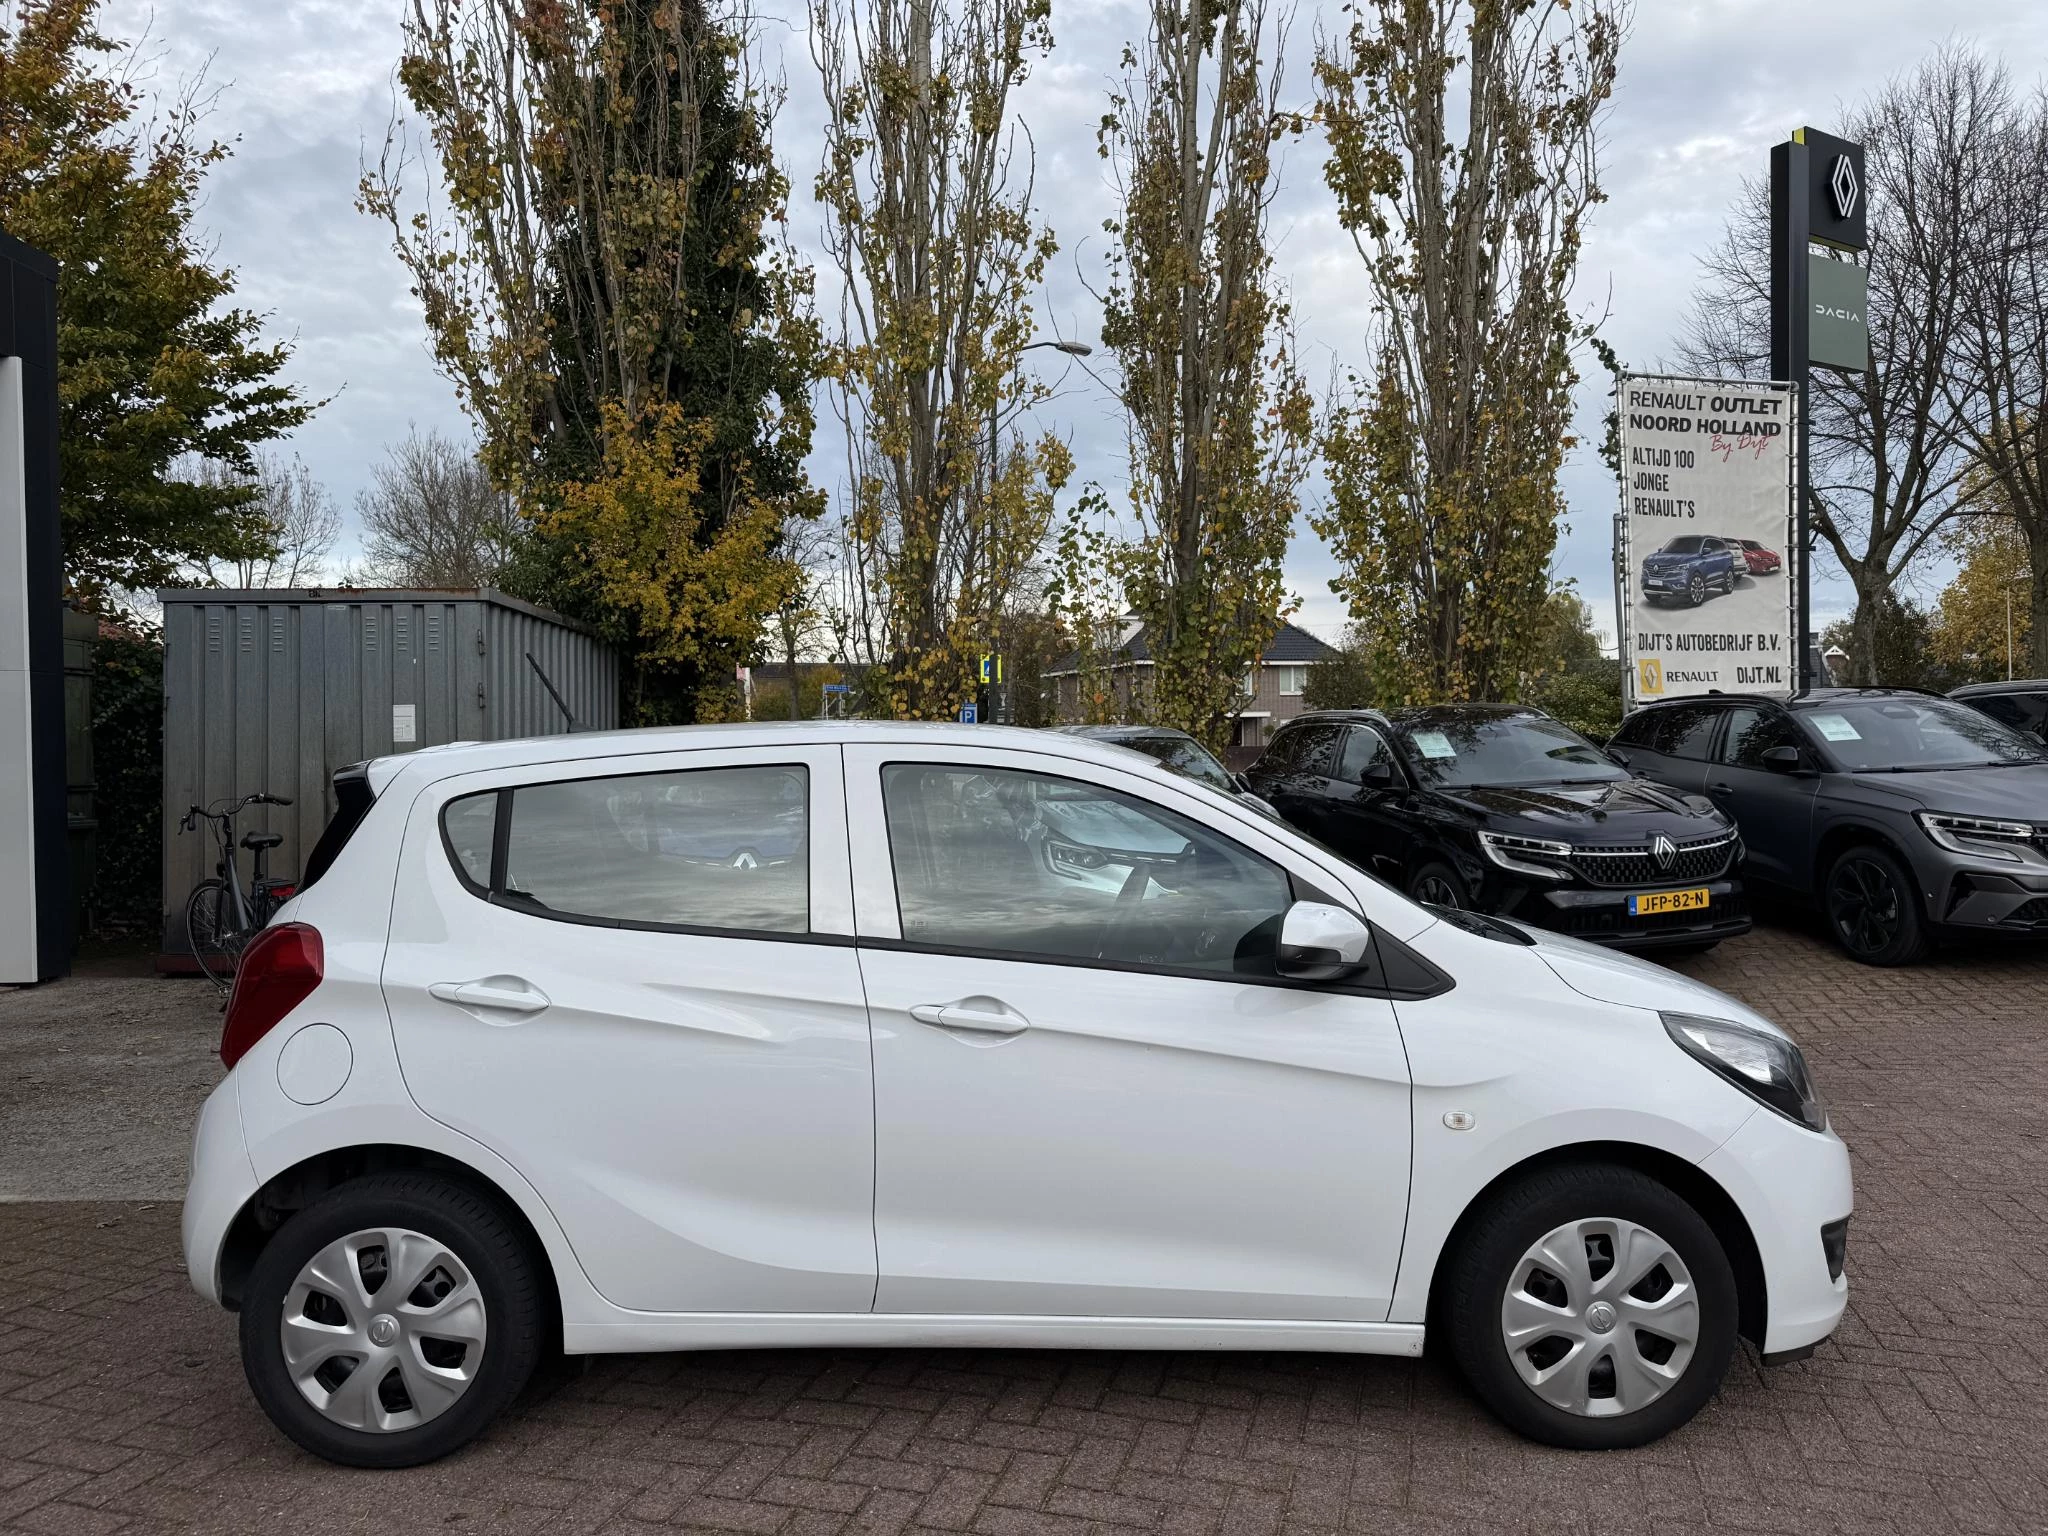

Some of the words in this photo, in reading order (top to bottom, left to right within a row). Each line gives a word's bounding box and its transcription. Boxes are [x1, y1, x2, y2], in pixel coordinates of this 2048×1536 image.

[1815, 304, 1860, 322] DACIA
[1630, 391, 1706, 411] RENAULT
[1711, 396, 1782, 415] OUTLET
[1630, 414, 1692, 432] NOORD
[1697, 419, 1781, 436] HOLLAND
[1632, 447, 1671, 467] ALTIJD
[1674, 450, 1695, 468] 100
[1710, 434, 1734, 463] By
[1634, 472, 1669, 492] JONGE
[1635, 497, 1695, 518] RENAULT'S
[1638, 632, 1672, 651] DIJT'S
[1676, 634, 1753, 651] AUTOBEDRIJF
[1758, 634, 1781, 651] B.V.
[1666, 671, 1719, 682] RENAULT
[1737, 667, 1782, 684] DIJT.NL
[1643, 892, 1704, 912] JFP-82-N
